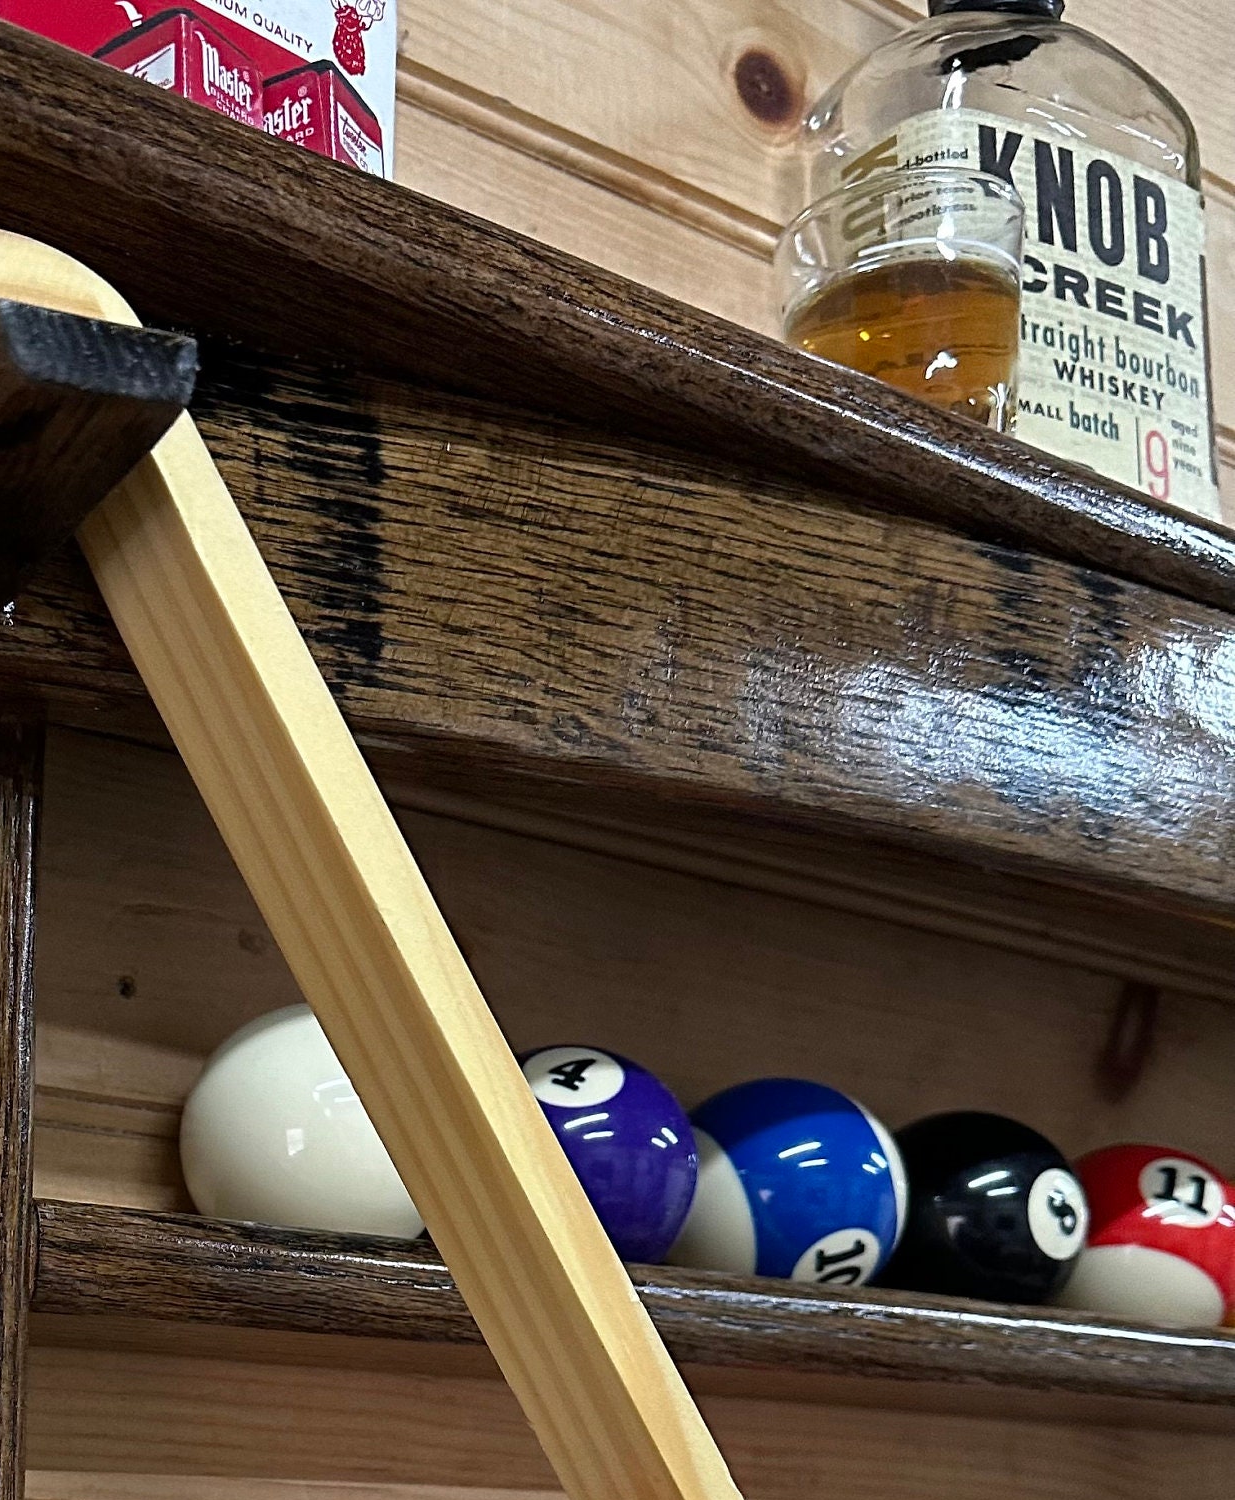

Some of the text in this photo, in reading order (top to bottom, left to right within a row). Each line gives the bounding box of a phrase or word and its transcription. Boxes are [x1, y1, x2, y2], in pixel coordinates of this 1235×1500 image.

[252, 13, 313, 53] QUALITY
[194, 30, 253, 112] Master
[263, 96, 313, 136] aster
[978, 124, 1170, 285] KNOB
[1021, 254, 1196, 349] CREEK
[1021, 313, 1200, 399] traight bourbon
[1053, 358, 1165, 411] WHISKEY
[1017, 398, 1120, 441] MALL batch
[1145, 430, 1170, 500] 9
[548, 1058, 597, 1091] 4
[1047, 1189, 1077, 1236] 8
[1153, 1166, 1209, 1216] 11
